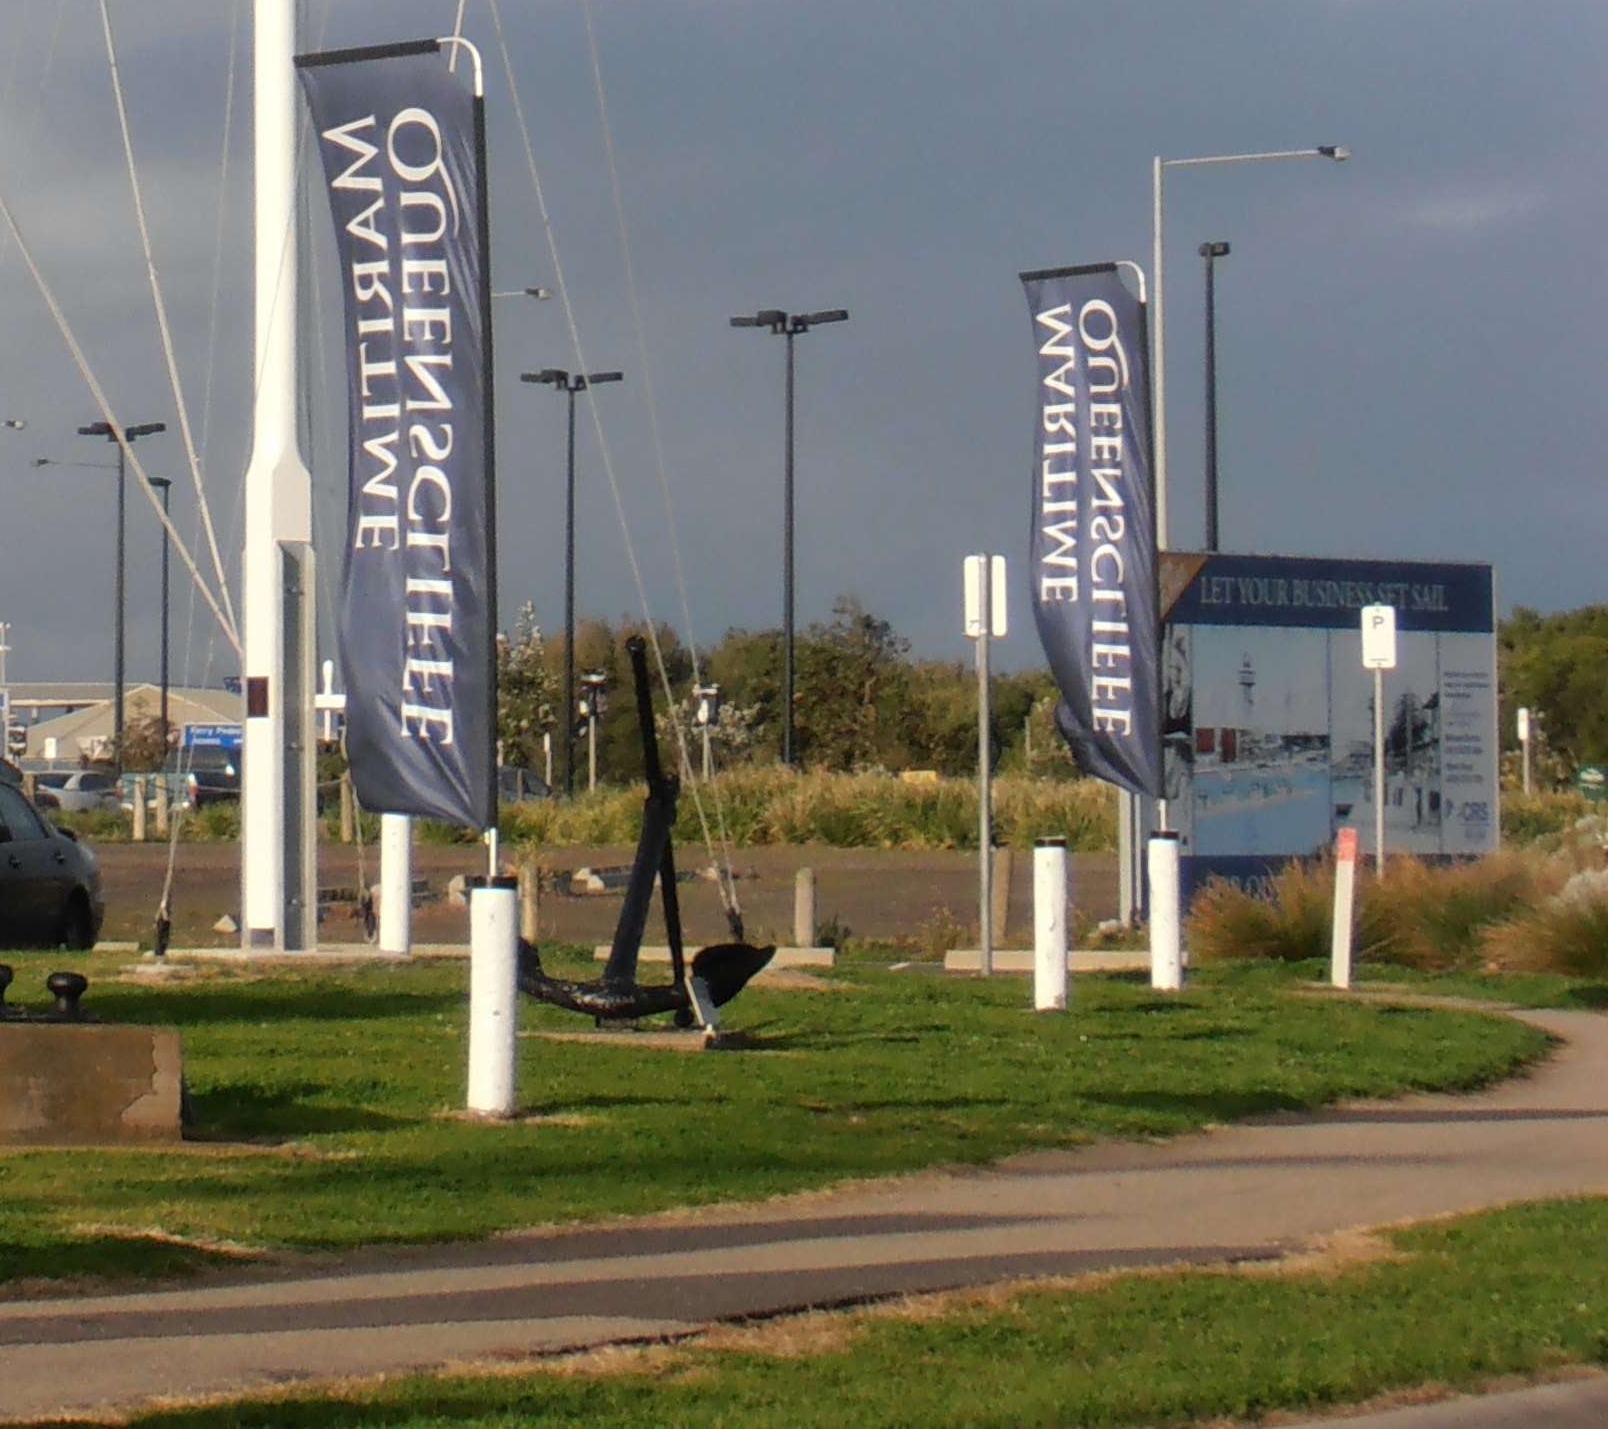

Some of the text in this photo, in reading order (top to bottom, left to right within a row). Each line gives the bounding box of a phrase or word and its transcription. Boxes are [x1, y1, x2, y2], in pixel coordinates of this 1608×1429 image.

[1200, 576, 1234, 604] LET
[1236, 577, 1290, 607] YOUR
[1293, 580, 1373, 609] BUSINESS
[1372, 615, 1385, 630] P
